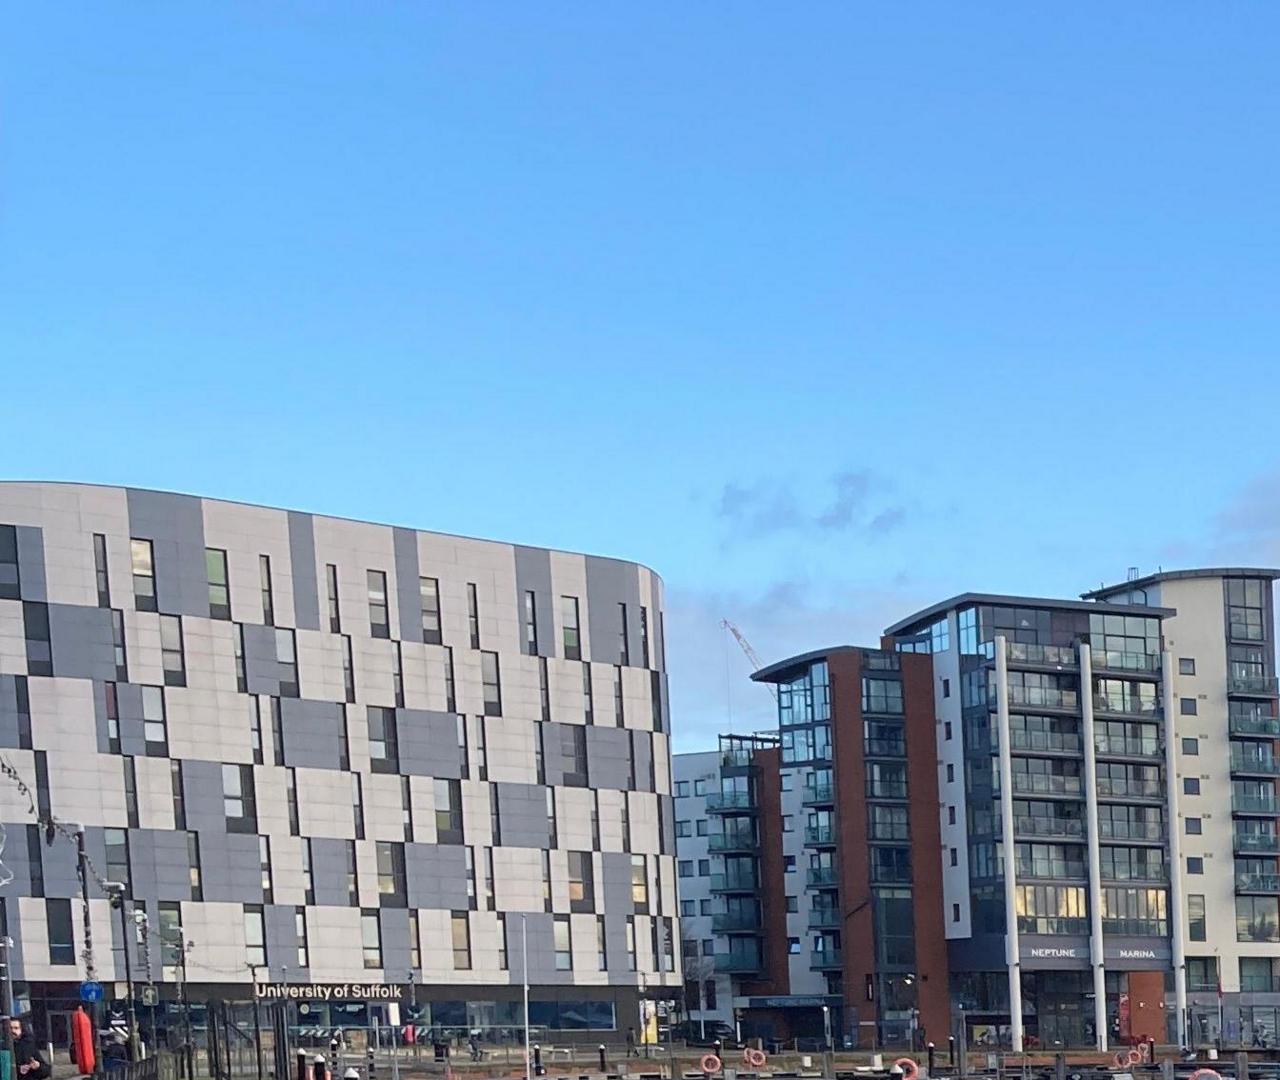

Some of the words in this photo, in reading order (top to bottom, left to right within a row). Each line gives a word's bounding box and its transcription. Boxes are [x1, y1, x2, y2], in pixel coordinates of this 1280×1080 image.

[1031, 948, 1076, 957] NEPTUNE
[1119, 949, 1156, 959] MARINA
[256, 983, 332, 1000] University
[334, 984, 349, 998] of
[352, 983, 402, 998] Suffolk
